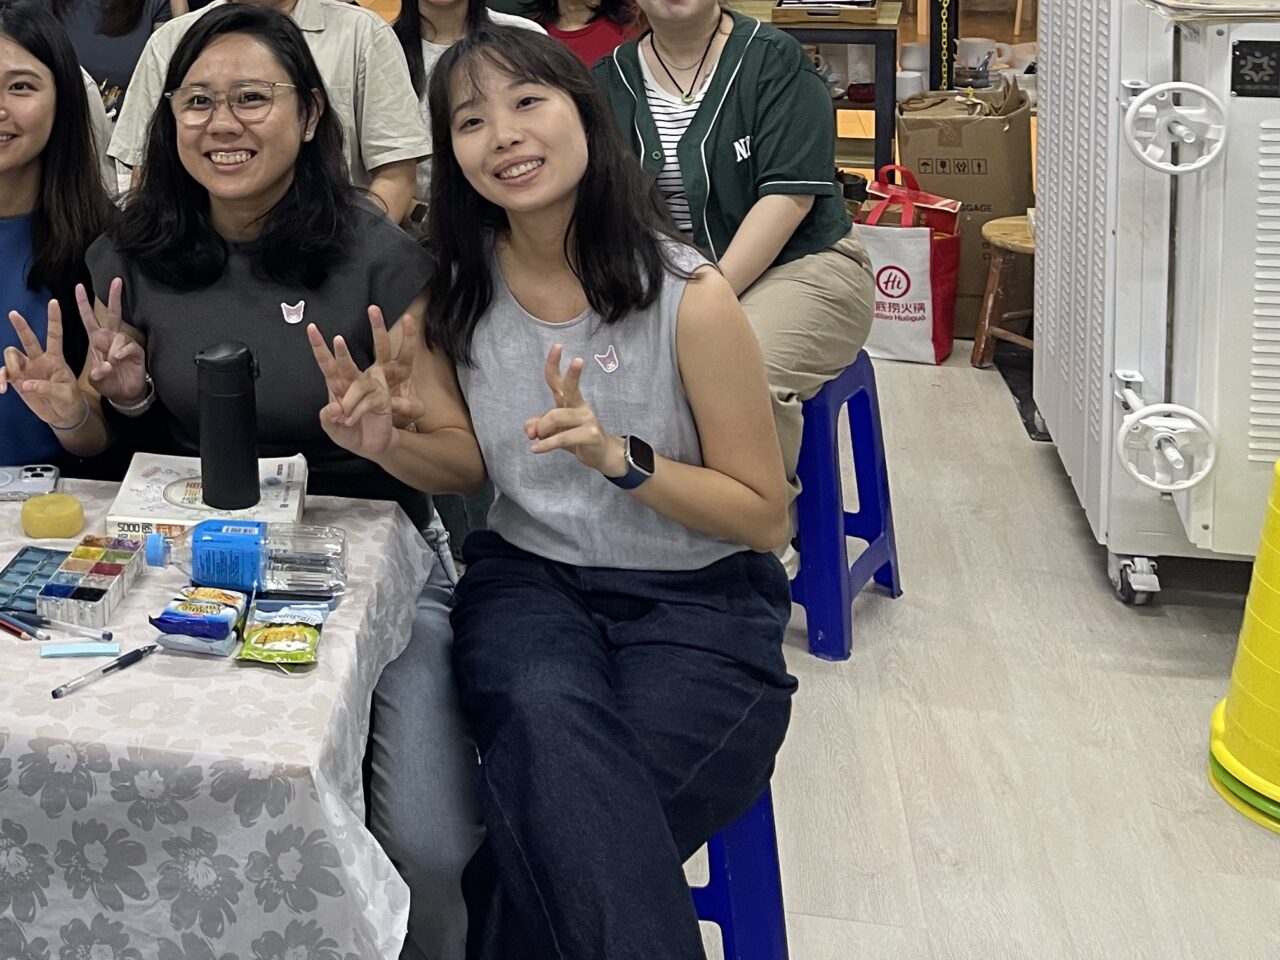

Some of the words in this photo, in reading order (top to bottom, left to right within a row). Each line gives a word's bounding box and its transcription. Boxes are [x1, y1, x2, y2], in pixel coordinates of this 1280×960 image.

[960, 203, 993, 213] GGAGE
[883, 271, 903, 291] Hi
[875, 301, 926, 314] 底捞火锅
[117, 522, 140, 533] 5000
